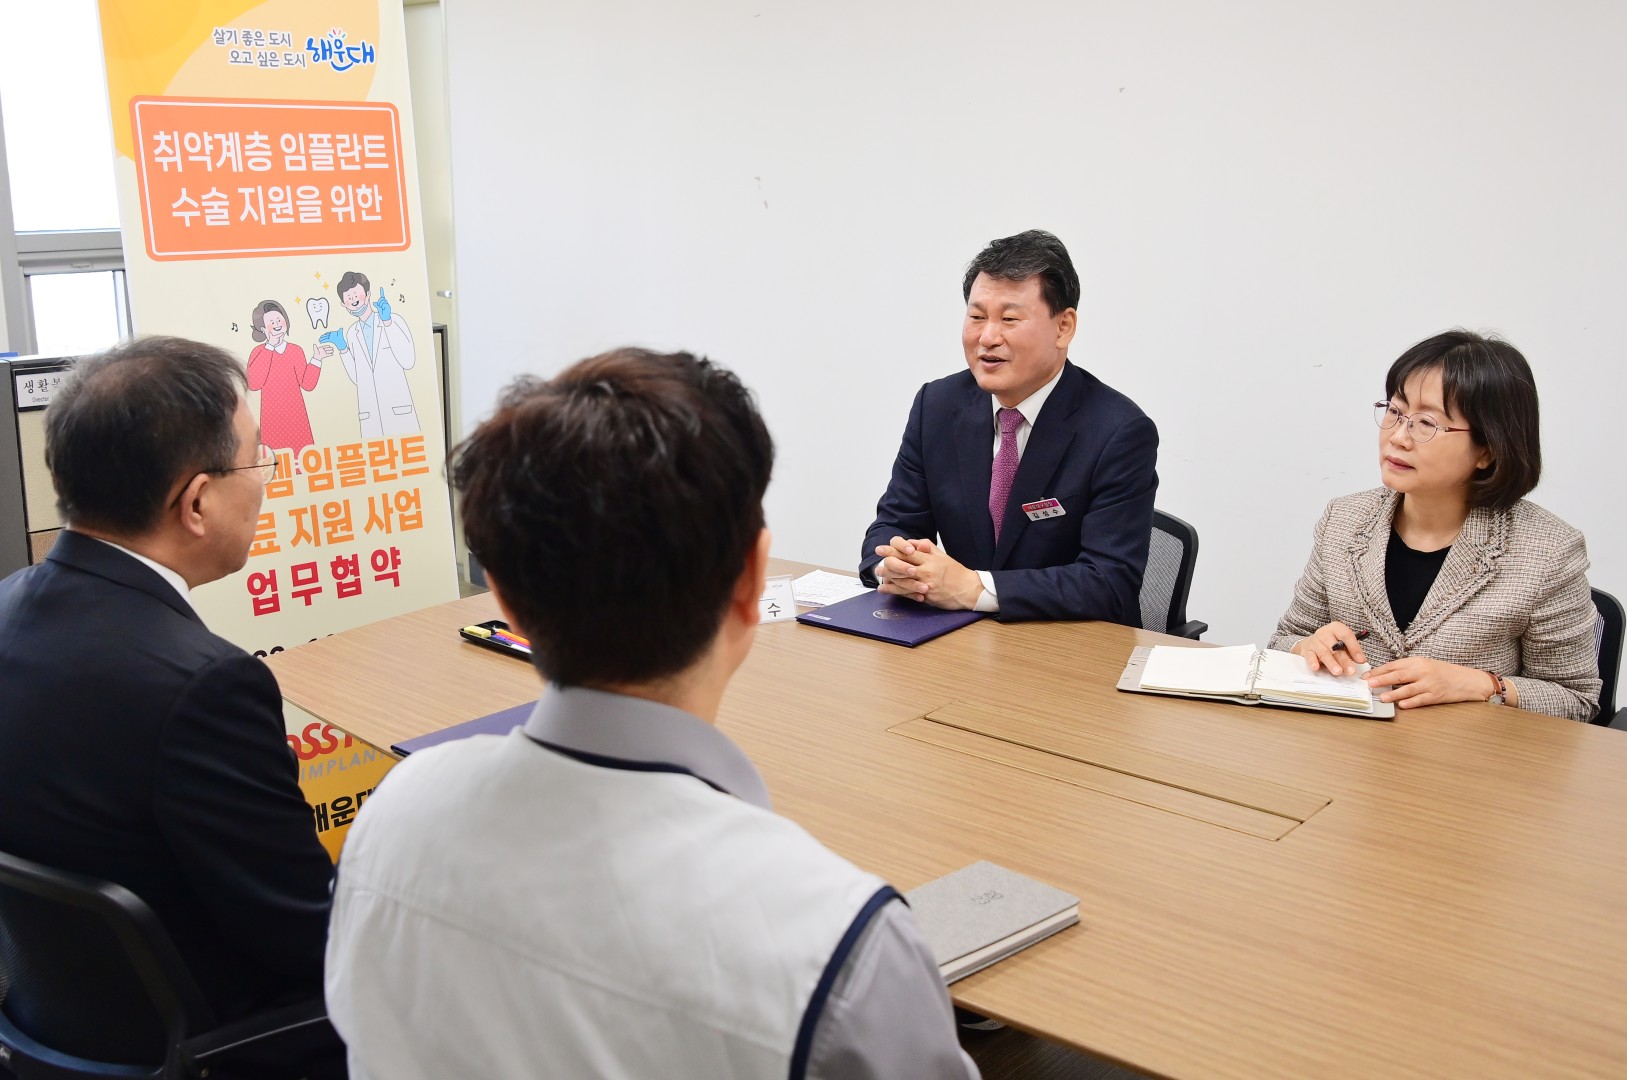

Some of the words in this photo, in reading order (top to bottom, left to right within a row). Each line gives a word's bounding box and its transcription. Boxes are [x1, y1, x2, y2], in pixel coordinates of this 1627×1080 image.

[213, 28, 238, 45] 살기
[241, 30, 265, 47] 좋은
[268, 31, 292, 48] 도시
[229, 50, 254, 65] 오고
[257, 51, 280, 68] 싶은
[283, 53, 307, 68] 도시
[306, 37, 375, 72] 해운대
[152, 130, 272, 173] 취약계층
[280, 132, 389, 172] 임플란트
[171, 186, 230, 227] 수술
[237, 185, 323, 226] 지원을
[330, 183, 383, 223] 위한
[302, 435, 430, 493] 임플란트
[288, 498, 355, 547] 지원
[363, 487, 423, 535] 사업
